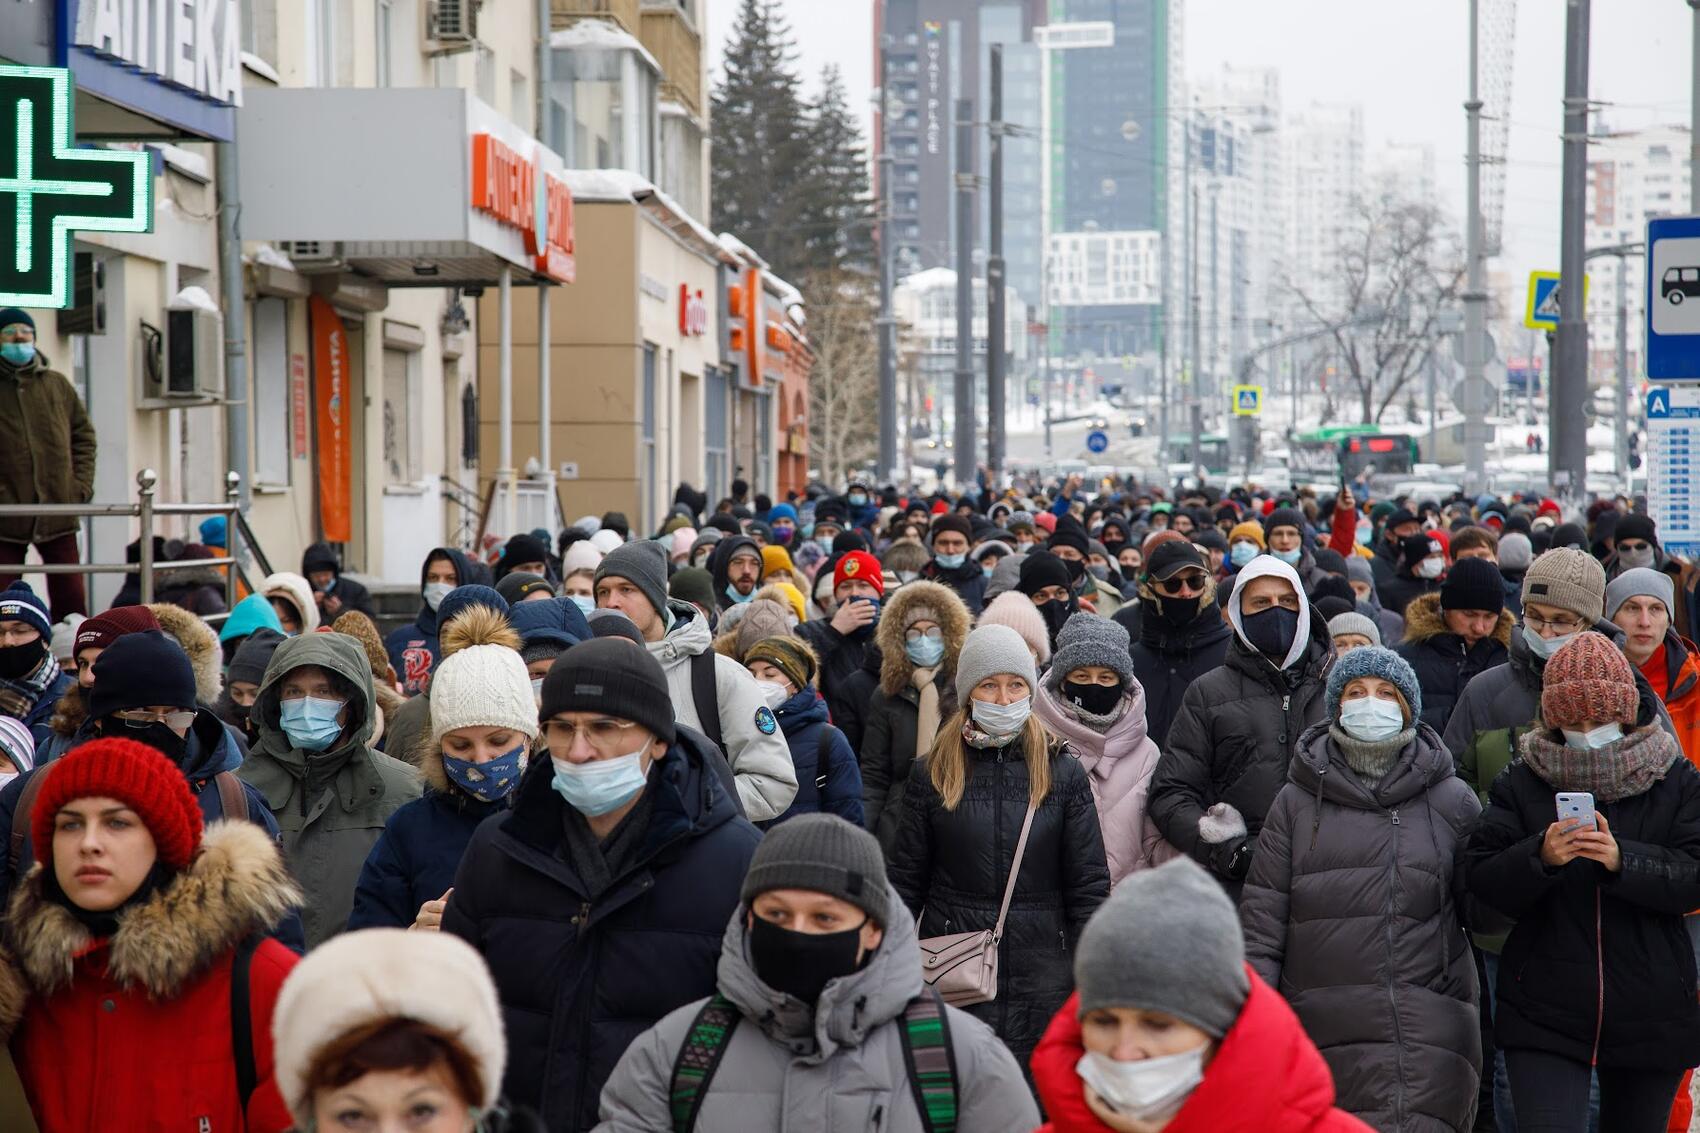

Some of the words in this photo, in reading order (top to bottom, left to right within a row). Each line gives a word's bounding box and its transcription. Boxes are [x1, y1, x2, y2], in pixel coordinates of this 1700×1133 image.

[927, 42, 940, 94] HYATT
[927, 98, 940, 154] PLACE
[1650, 396, 1667, 414] А
